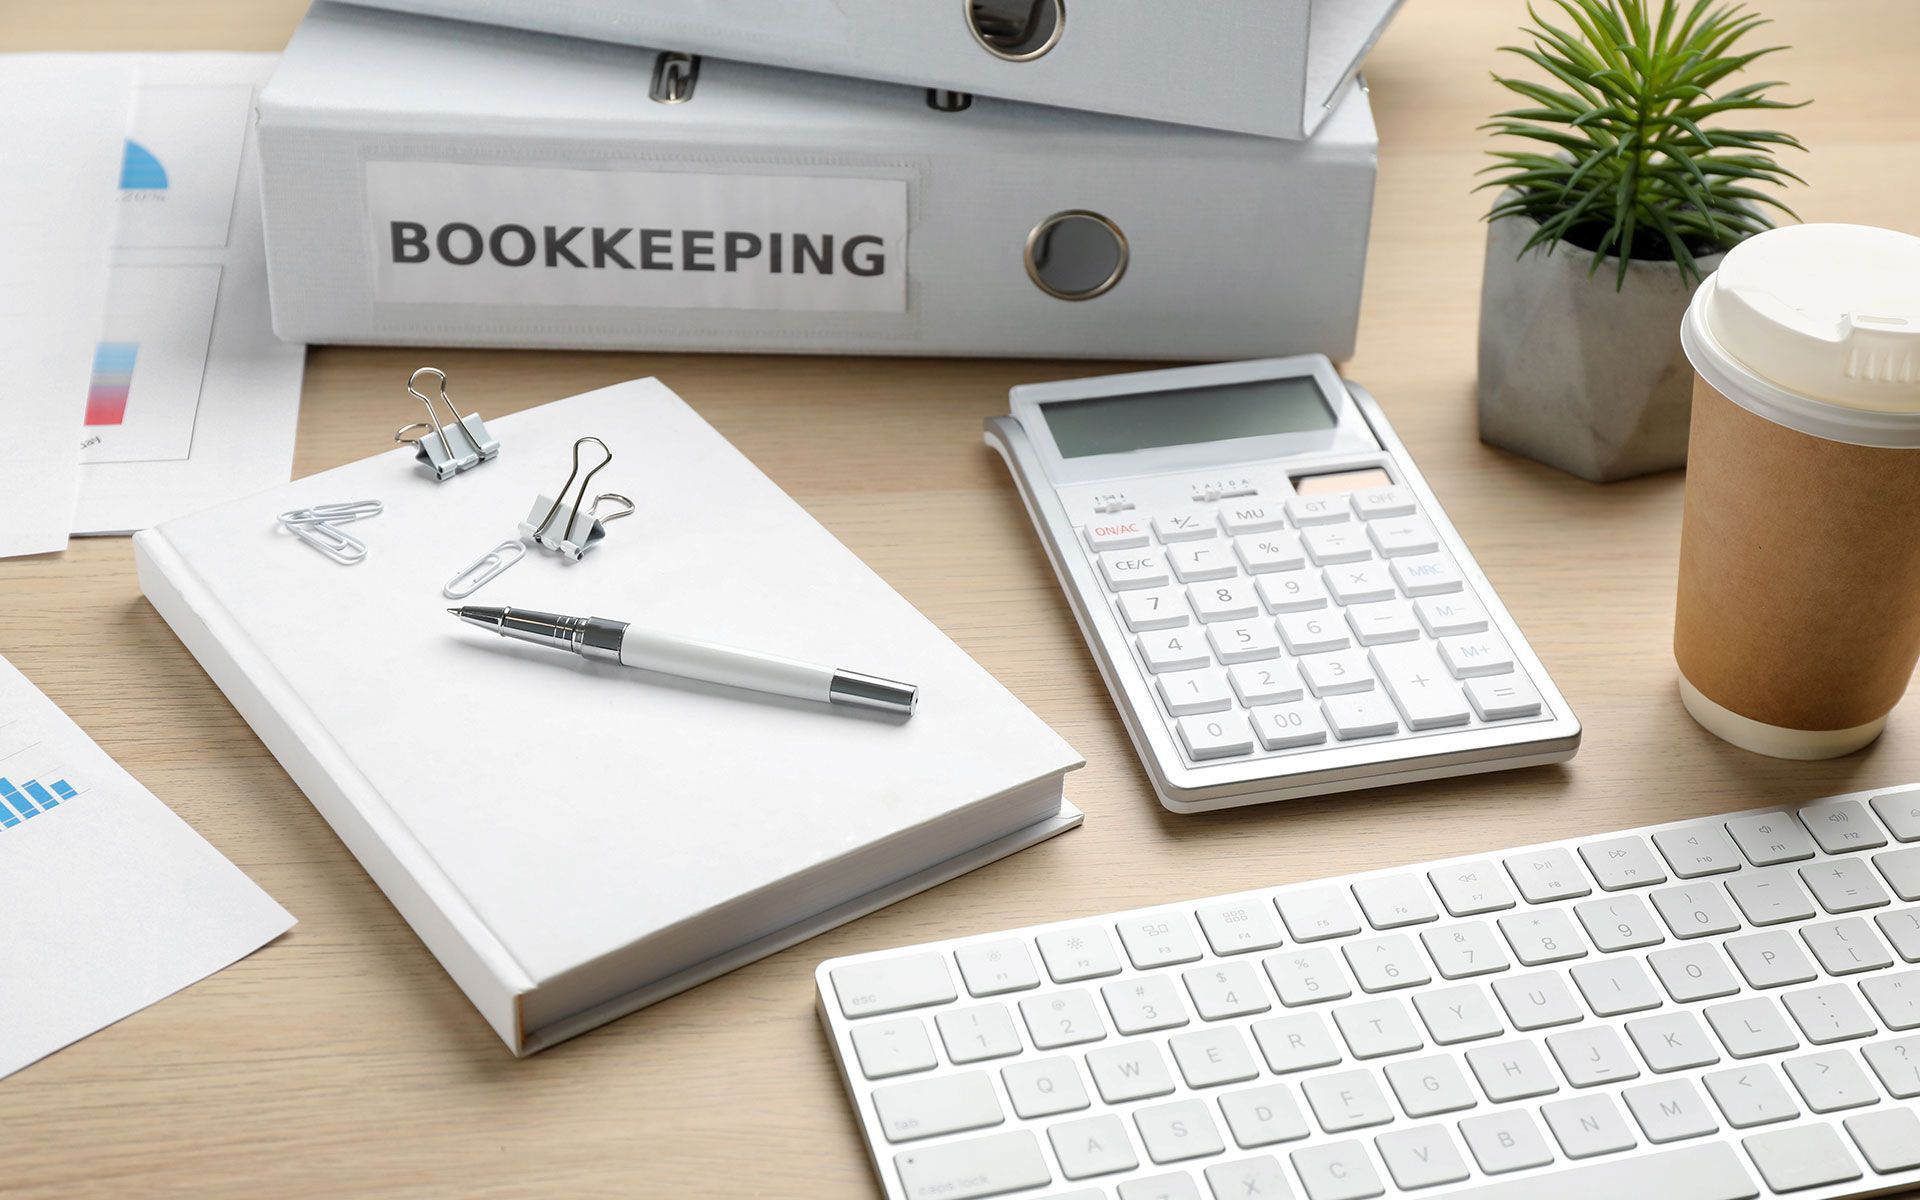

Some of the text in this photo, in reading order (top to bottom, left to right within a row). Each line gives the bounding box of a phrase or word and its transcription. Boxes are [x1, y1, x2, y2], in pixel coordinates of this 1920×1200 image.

[390, 221, 886, 278] BOOKKEEPING
[1305, 500, 1327, 512] GT
[1367, 492, 1396, 505] OFF
[1235, 508, 1265, 520] MU
[1094, 522, 1140, 537] ON/AC
[1258, 542, 1280, 554] %
[1114, 558, 1154, 571] CE/C
[1406, 563, 1444, 577] MRC
[1284, 580, 1300, 594] 9
[1216, 588, 1233, 602] 8
[1146, 596, 1160, 611] 7
[1306, 620, 1322, 634] 6
[1235, 628, 1252, 643] 5
[1167, 637, 1184, 651] 4
[1459, 644, 1490, 658] M+
[1328, 662, 1346, 677] 3
[1257, 670, 1276, 686] 2
[1187, 679, 1200, 694] 1
[1273, 711, 1303, 729] 00
[1843, 831, 1859, 840] F12
[1696, 856, 1713, 864] F10
[1623, 868, 1637, 877] F9
[1548, 881, 1562, 889] F8
[1238, 932, 1252, 940] F4
[1617, 923, 1633, 938] 9
[1541, 936, 1557, 951] 8
[1462, 950, 1474, 964] 7
[1761, 950, 1776, 965] P
[1384, 963, 1400, 978] 6
[1685, 963, 1703, 979] O
[1304, 976, 1320, 992] 5
[1225, 990, 1239, 1004] 4
[1528, 990, 1547, 1006] U
[1141, 1004, 1158, 1020] 3
[1448, 1004, 1463, 1020] Y
[1059, 1019, 1076, 1035] 2
[1368, 1018, 1383, 1034] T
[1743, 1019, 1762, 1034] L
[976, 1033, 987, 1048] 1
[1287, 1033, 1305, 1049] R
[1663, 1032, 1683, 1048] K
[1205, 1047, 1222, 1064] E
[1117, 1060, 1140, 1078] W
[1502, 1060, 1523, 1077] H
[1036, 1077, 1055, 1094] Q
[1422, 1075, 1440, 1092] G
[1339, 1090, 1353, 1107] F
[1254, 1105, 1273, 1123] D
[1659, 1100, 1683, 1117] M
[1170, 1120, 1189, 1138] S
[1579, 1115, 1601, 1133] N
[1087, 1137, 1104, 1154] A
[1496, 1131, 1516, 1149] B
[1412, 1146, 1429, 1163] V
[1328, 1161, 1348, 1180] C
[1242, 1178, 1261, 1196] X
